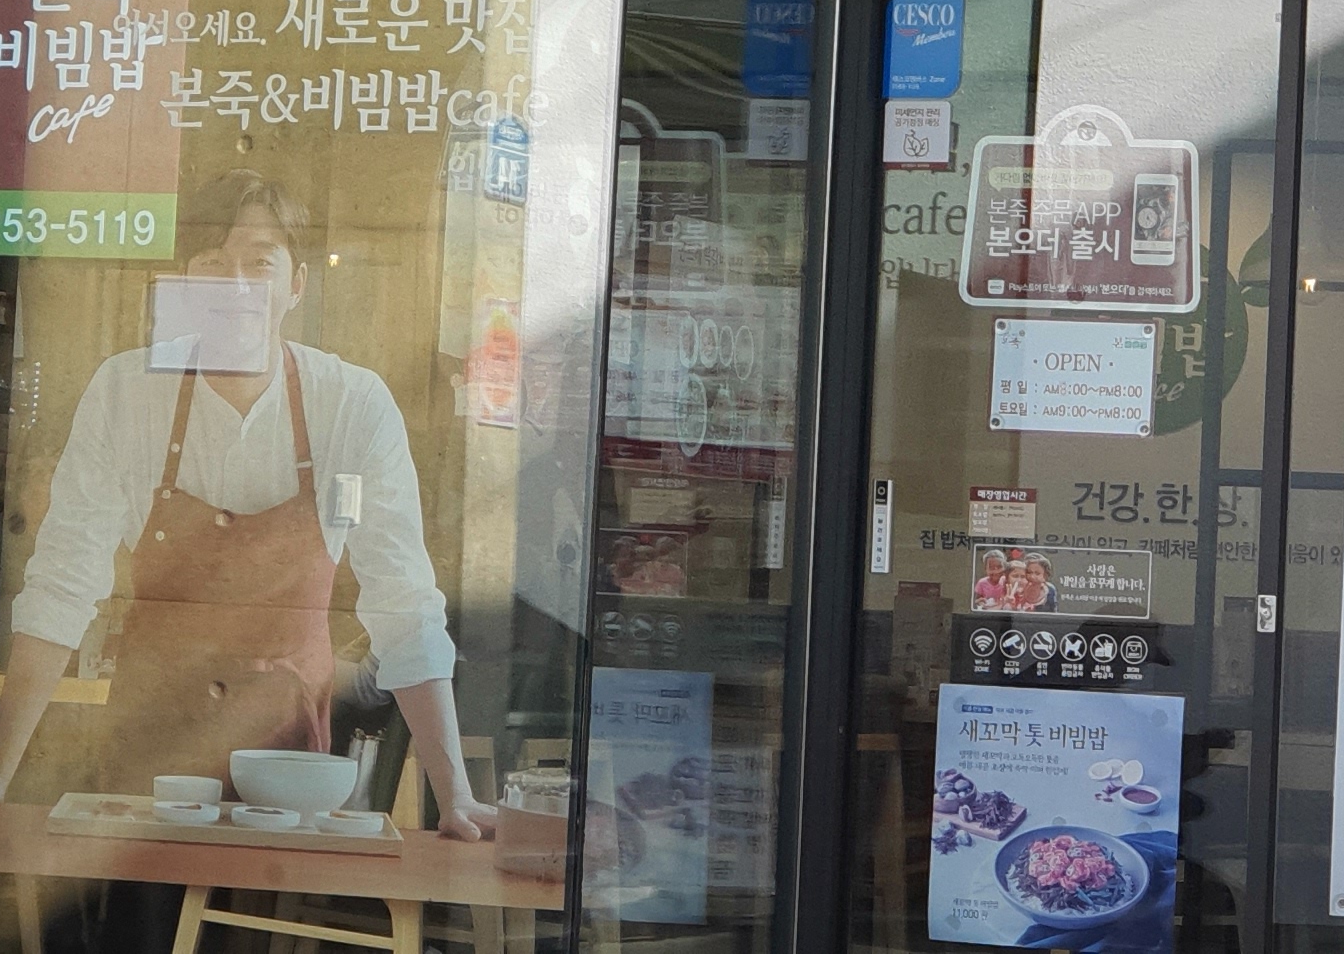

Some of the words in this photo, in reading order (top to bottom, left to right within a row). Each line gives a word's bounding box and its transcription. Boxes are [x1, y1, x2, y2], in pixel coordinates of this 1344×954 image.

[893, 3, 955, 26] CESCO
[882, 191, 967, 235] cafe
[986, 198, 1028, 225] 본죽
[985, 226, 1061, 260] 본오더
[1069, 226, 1120, 261] 출시
[1044, 352, 1103, 372] OPEN
[999, 402, 1028, 417] 토요일
[1086, 563, 1116, 577] 사랑은
[958, 719, 1021, 747] 새꼬막
[1024, 723, 1045, 747] 톳
[1049, 723, 1109, 751] 비빔밥
